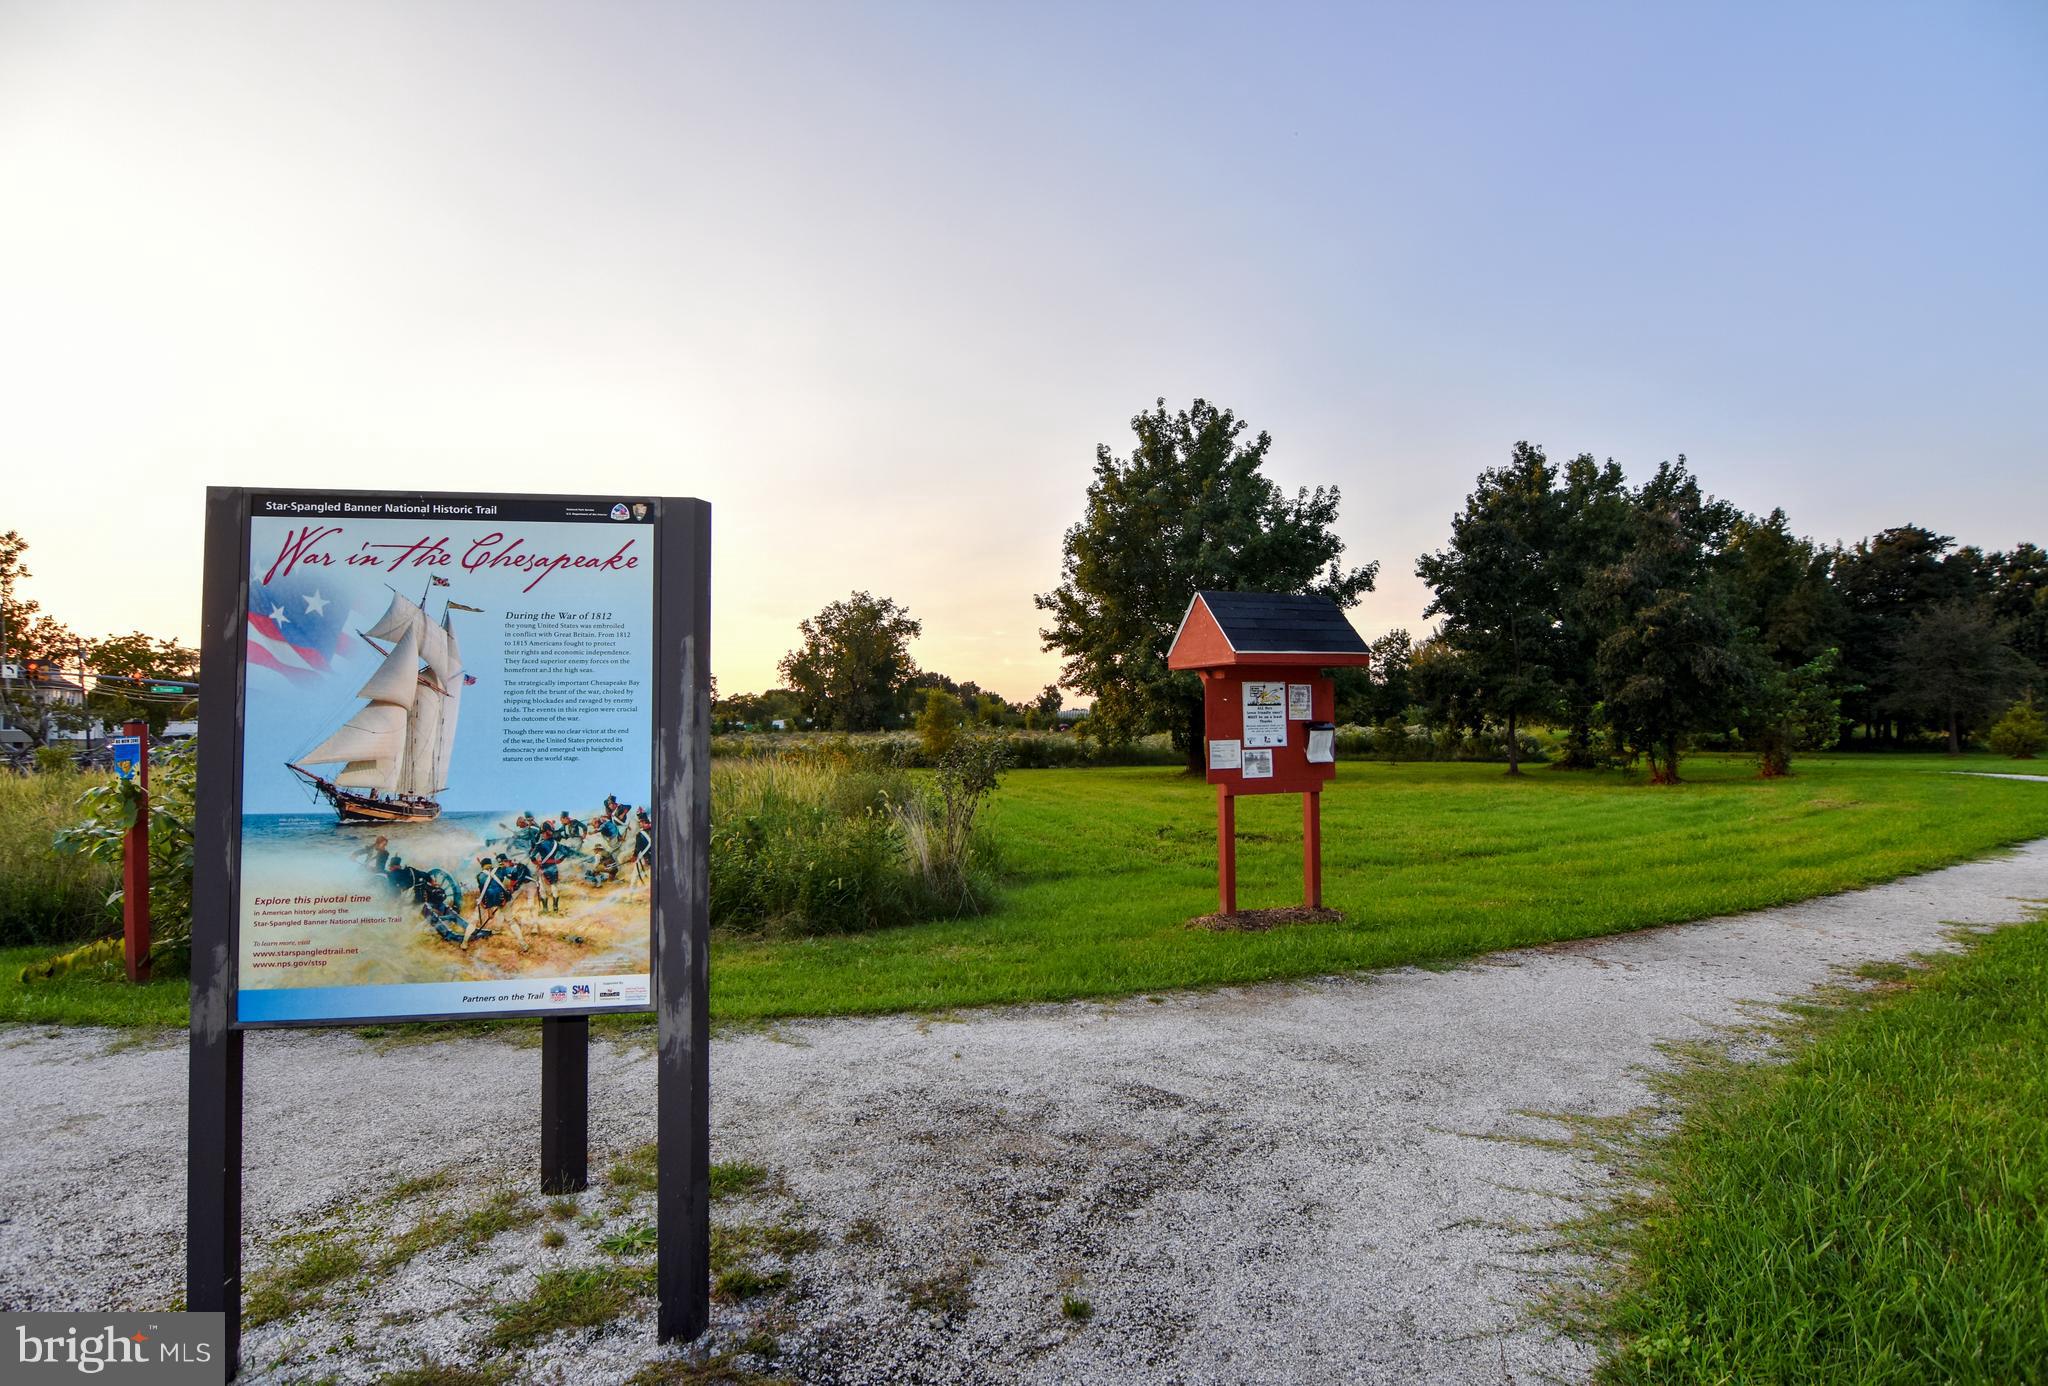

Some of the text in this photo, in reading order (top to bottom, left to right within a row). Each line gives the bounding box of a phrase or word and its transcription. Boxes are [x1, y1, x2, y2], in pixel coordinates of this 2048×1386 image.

[266, 501, 497, 514] Star-Spangled Banner National Historic Trail
[263, 526, 638, 593] War in the Chesapeake
[506, 612, 538, 621] During
[255, 894, 371, 906] Explore this pivotal time
[253, 948, 359, 957] www.starspangledtrail.net
[253, 960, 327, 968] www.nps.gov/stsp
[572, 984, 590, 995] SHA
[462, 995, 495, 1003] Partners
